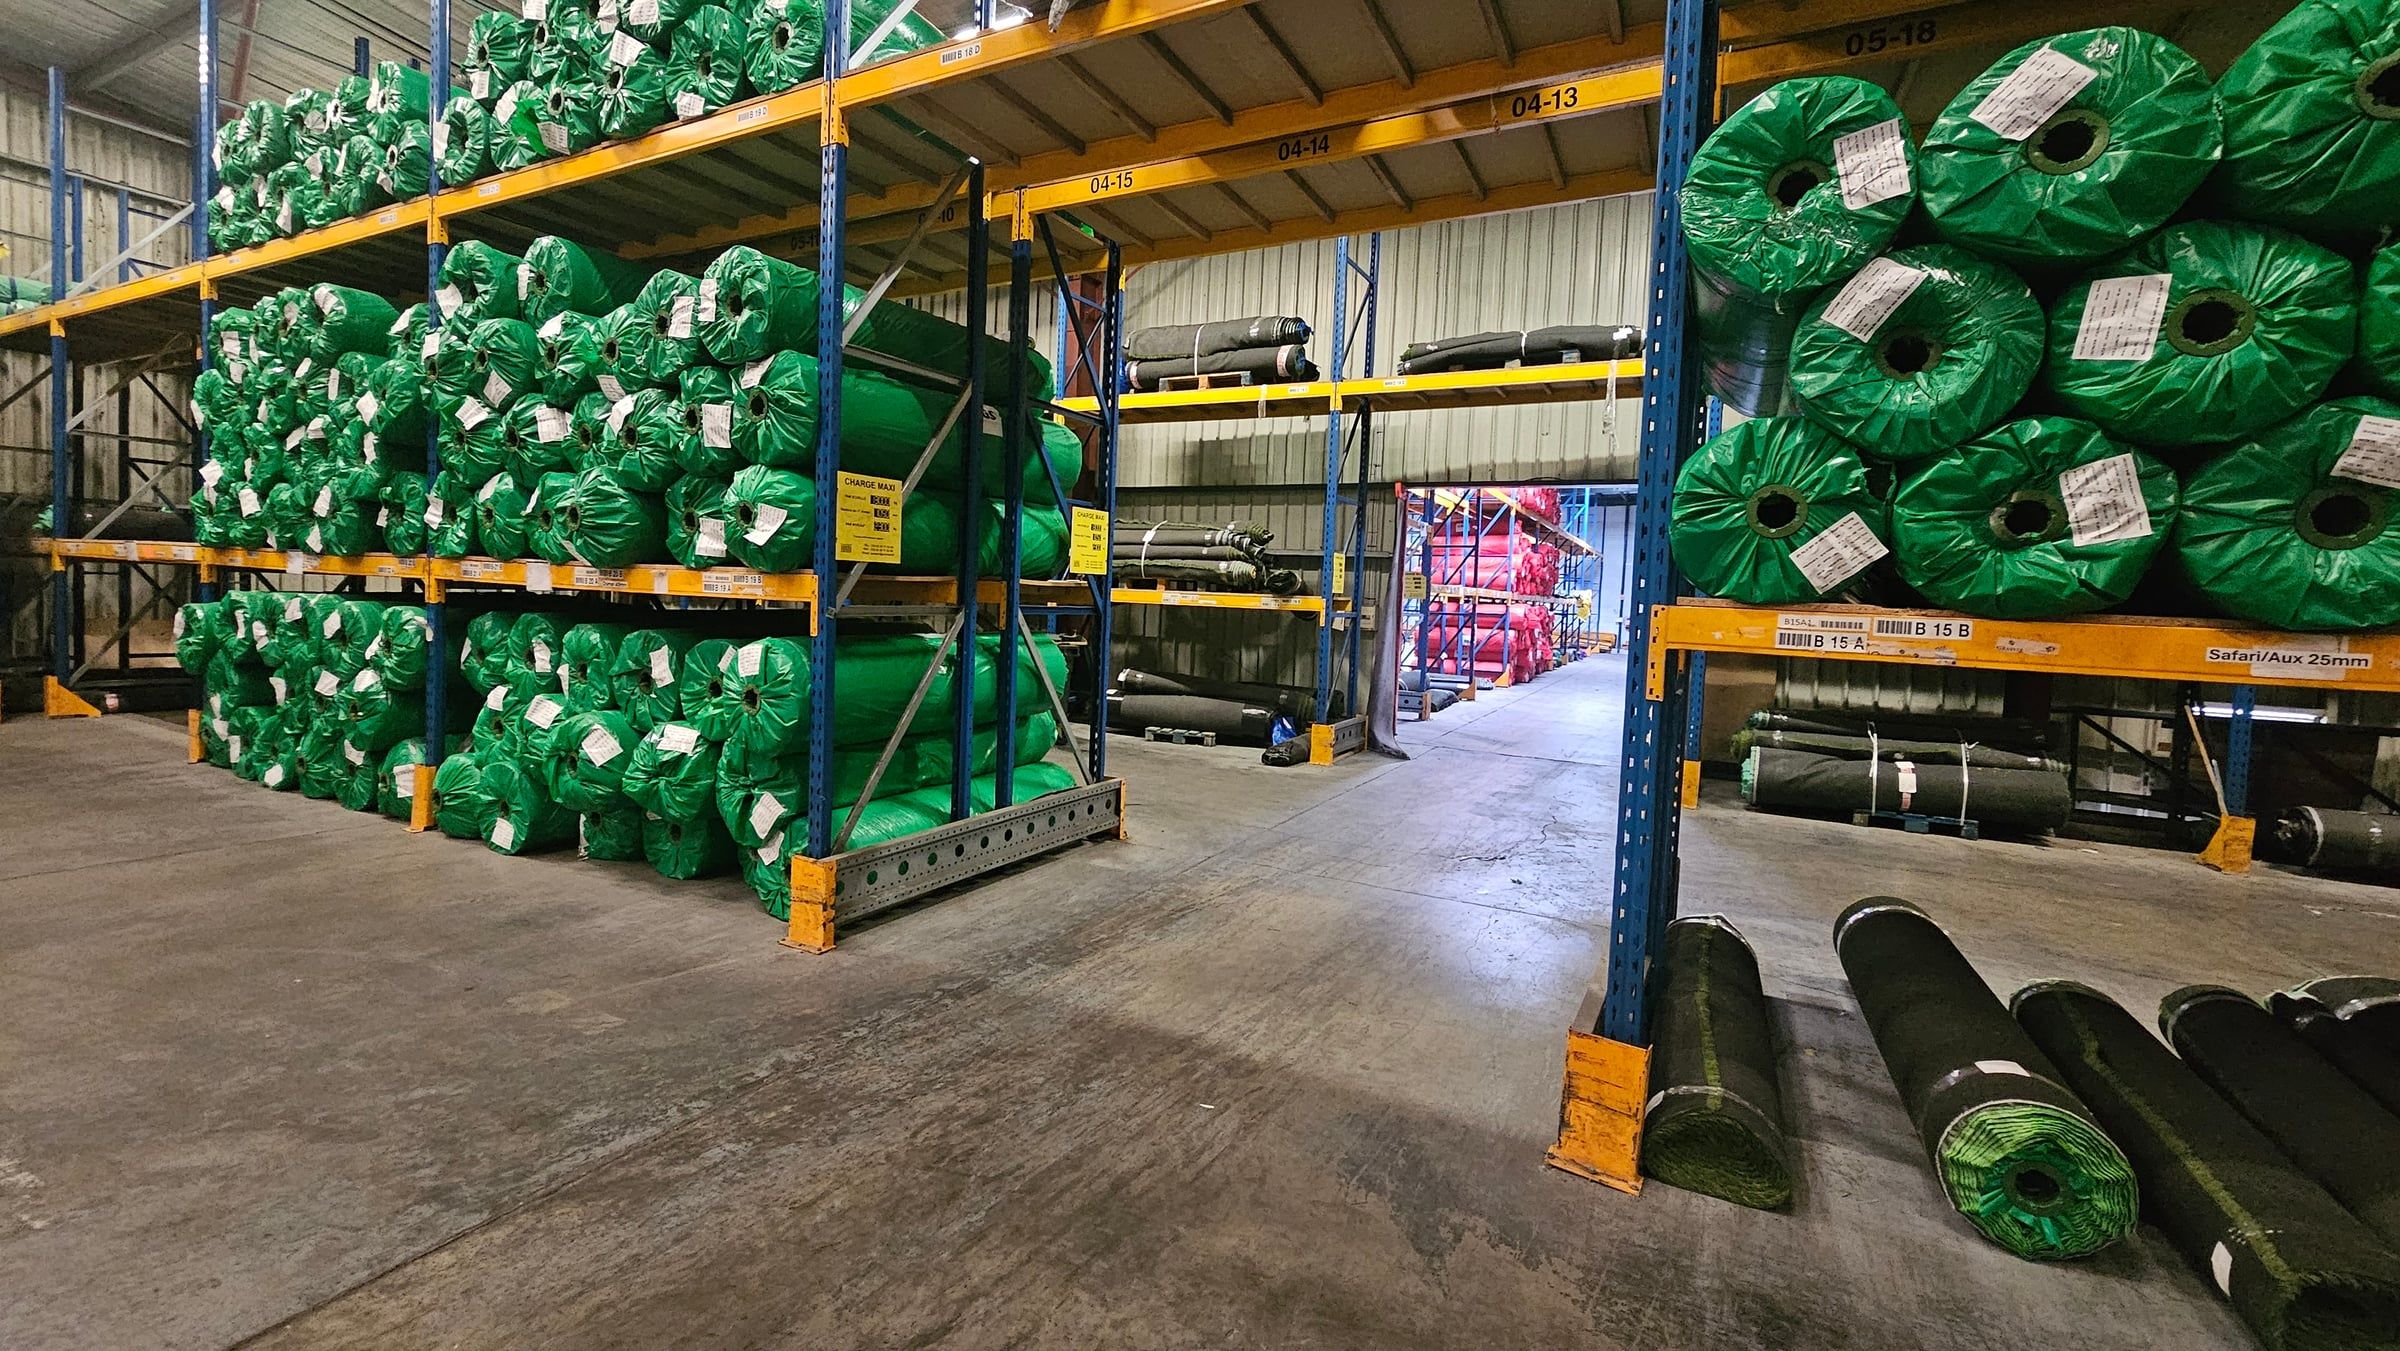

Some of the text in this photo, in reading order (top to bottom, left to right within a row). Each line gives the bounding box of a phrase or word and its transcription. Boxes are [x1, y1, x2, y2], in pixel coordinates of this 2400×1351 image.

[1846, 19, 1937, 56] 05-18
[1512, 86, 1578, 118] 04-13
[1278, 134, 1330, 161] 04-14
[1091, 171, 1133, 194] 04-15
[844, 477, 896, 492] CHARGE MAXI
[1914, 621, 1970, 638] B 15 B
[1814, 634, 1864, 650] B 15 A
[2208, 649, 2369, 668] Safari/Aux 25mm
